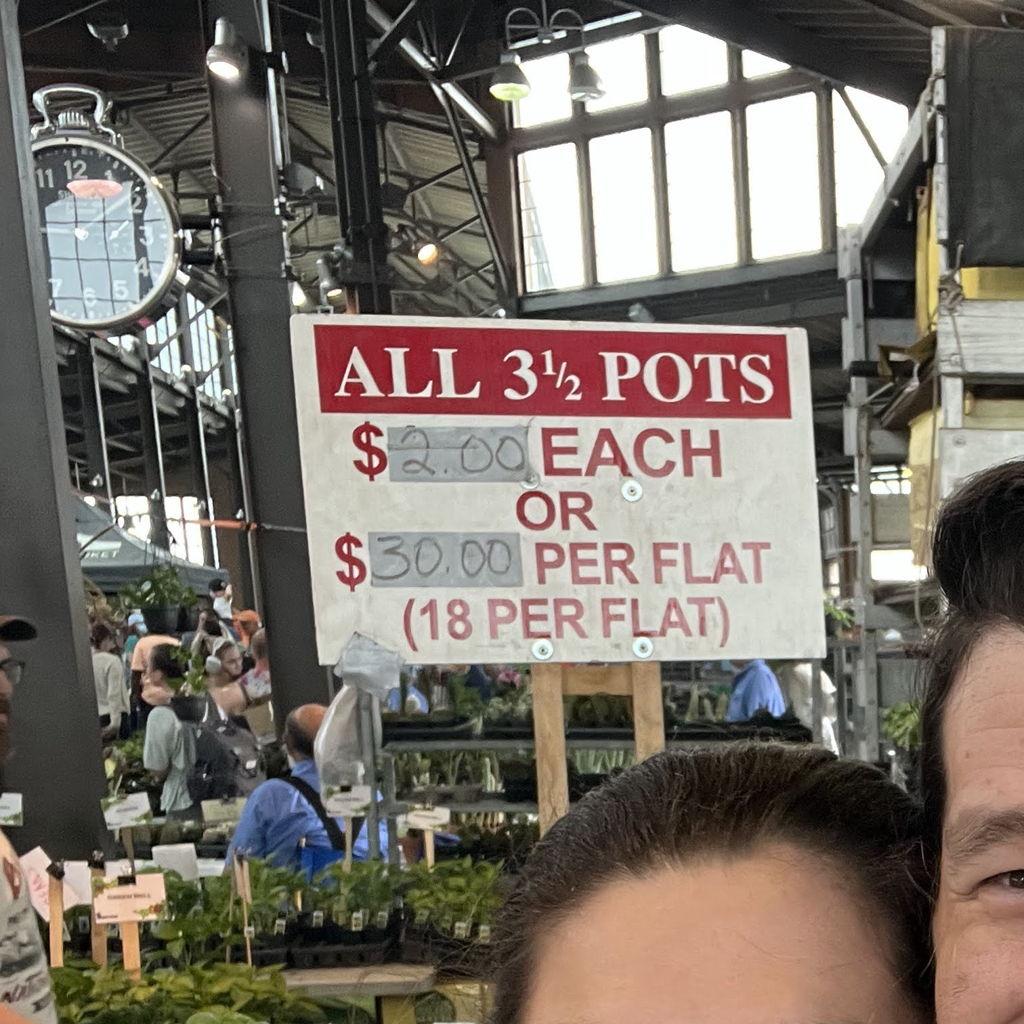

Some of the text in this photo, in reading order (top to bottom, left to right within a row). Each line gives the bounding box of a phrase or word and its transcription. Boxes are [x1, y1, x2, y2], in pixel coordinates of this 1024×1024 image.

[35, 168, 54, 189] 11
[64, 159, 89, 180] 12
[135, 256, 151, 278] 4
[83, 286, 98, 308] 6
[112, 280, 130, 300] 5
[333, 345, 482, 401] ALL
[598, 351, 776, 405] POTS
[541, 427, 724, 479] EACH
[515, 490, 598, 532] OR
[535, 541, 640, 585] PER
[652, 541, 772, 585] FLAT
[402, 595, 731, 653] (18 PER FLAT)
